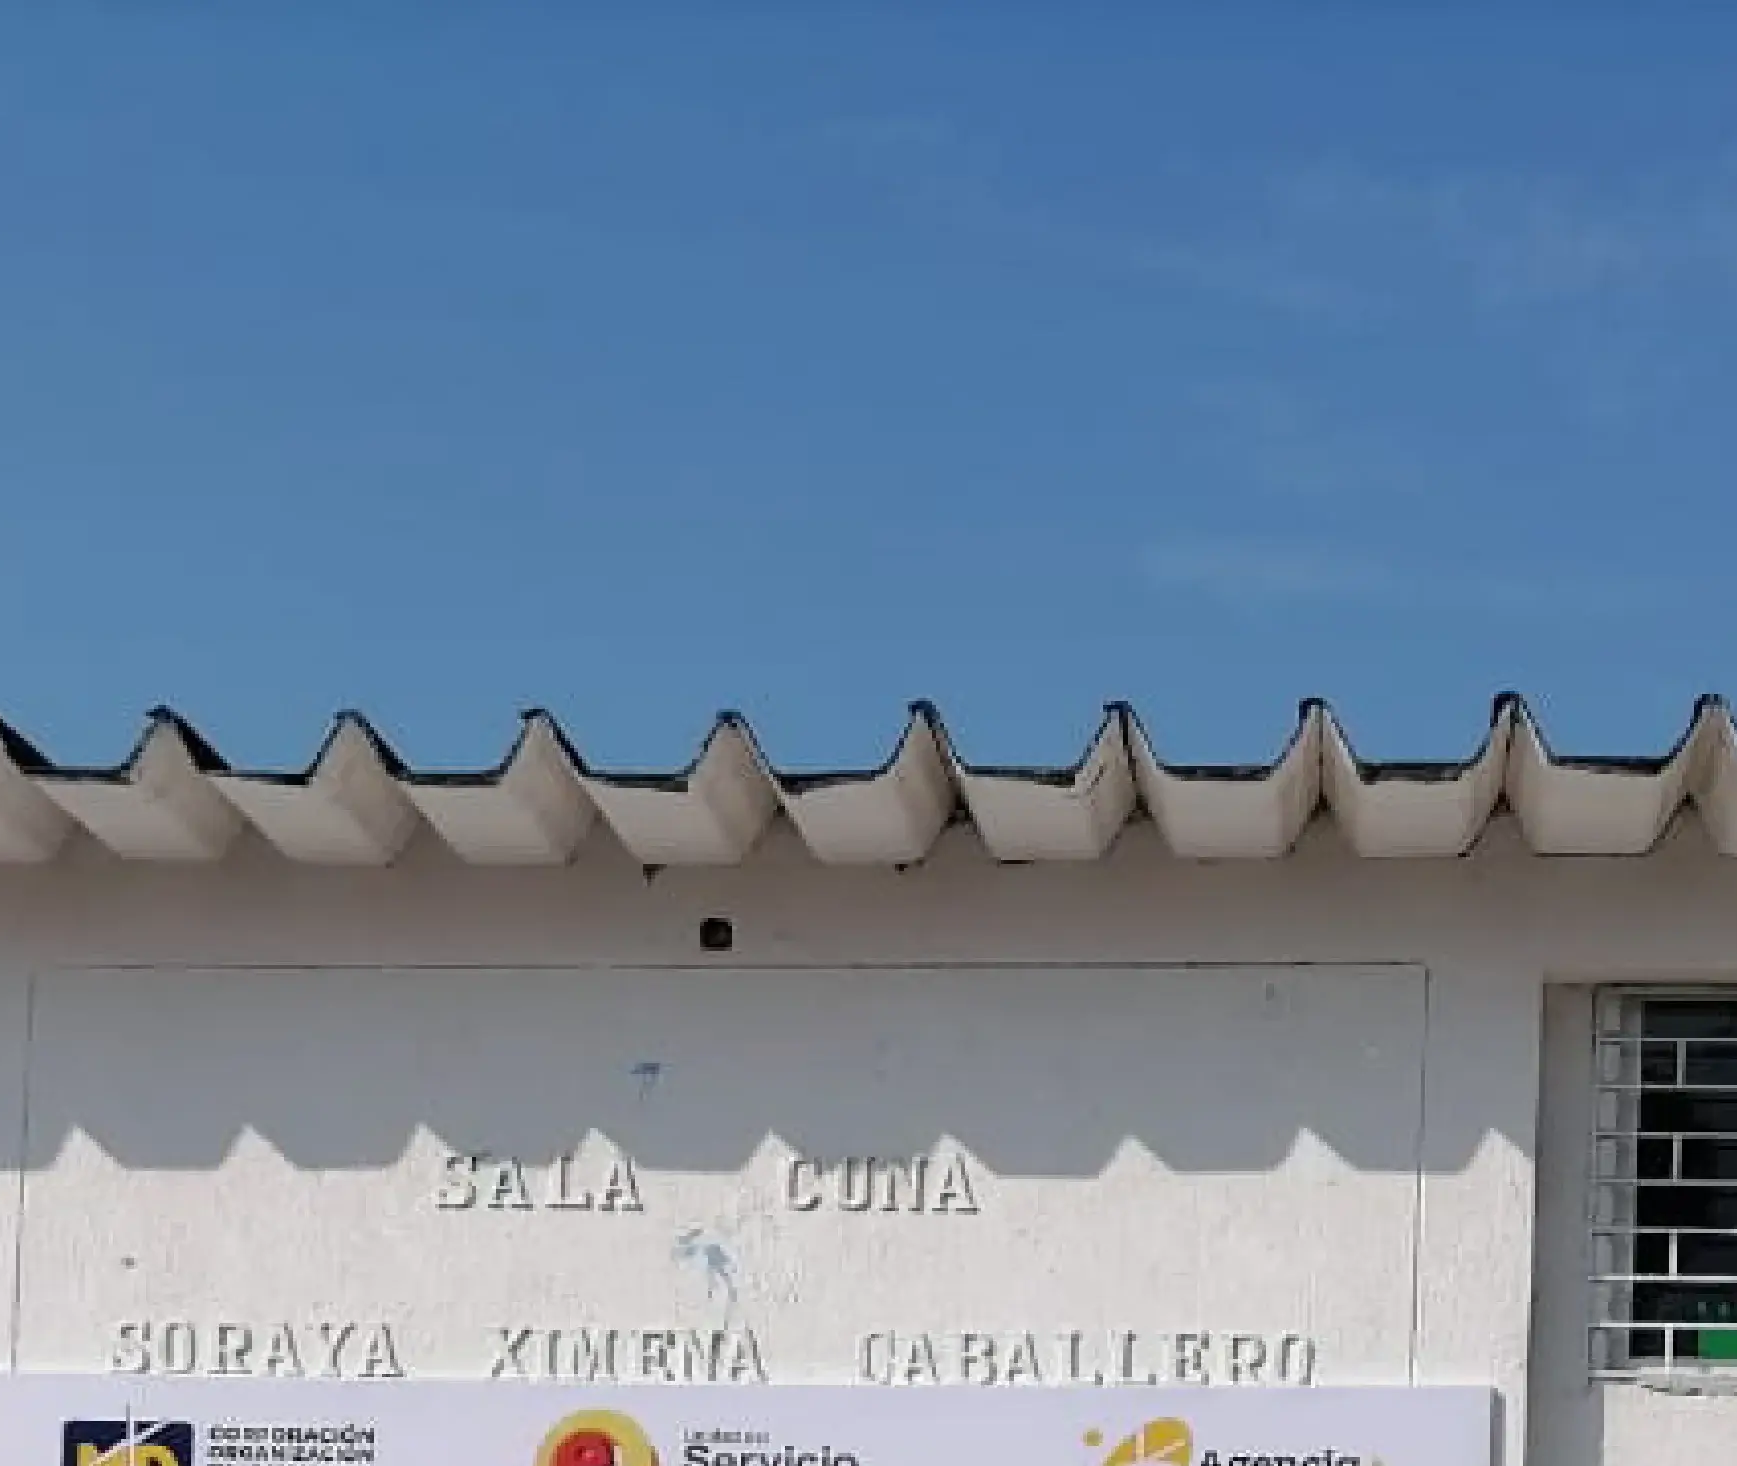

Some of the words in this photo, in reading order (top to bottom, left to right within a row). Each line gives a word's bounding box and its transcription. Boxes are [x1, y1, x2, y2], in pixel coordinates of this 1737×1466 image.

[435, 1155, 645, 1212] SALA
[785, 1156, 981, 1216] CUNA
[112, 1320, 407, 1379] SORAYA
[489, 1324, 771, 1386] XIMENA
[857, 1328, 1320, 1387] CABALLERO
[206, 1423, 376, 1445] CORPORACIÓN
